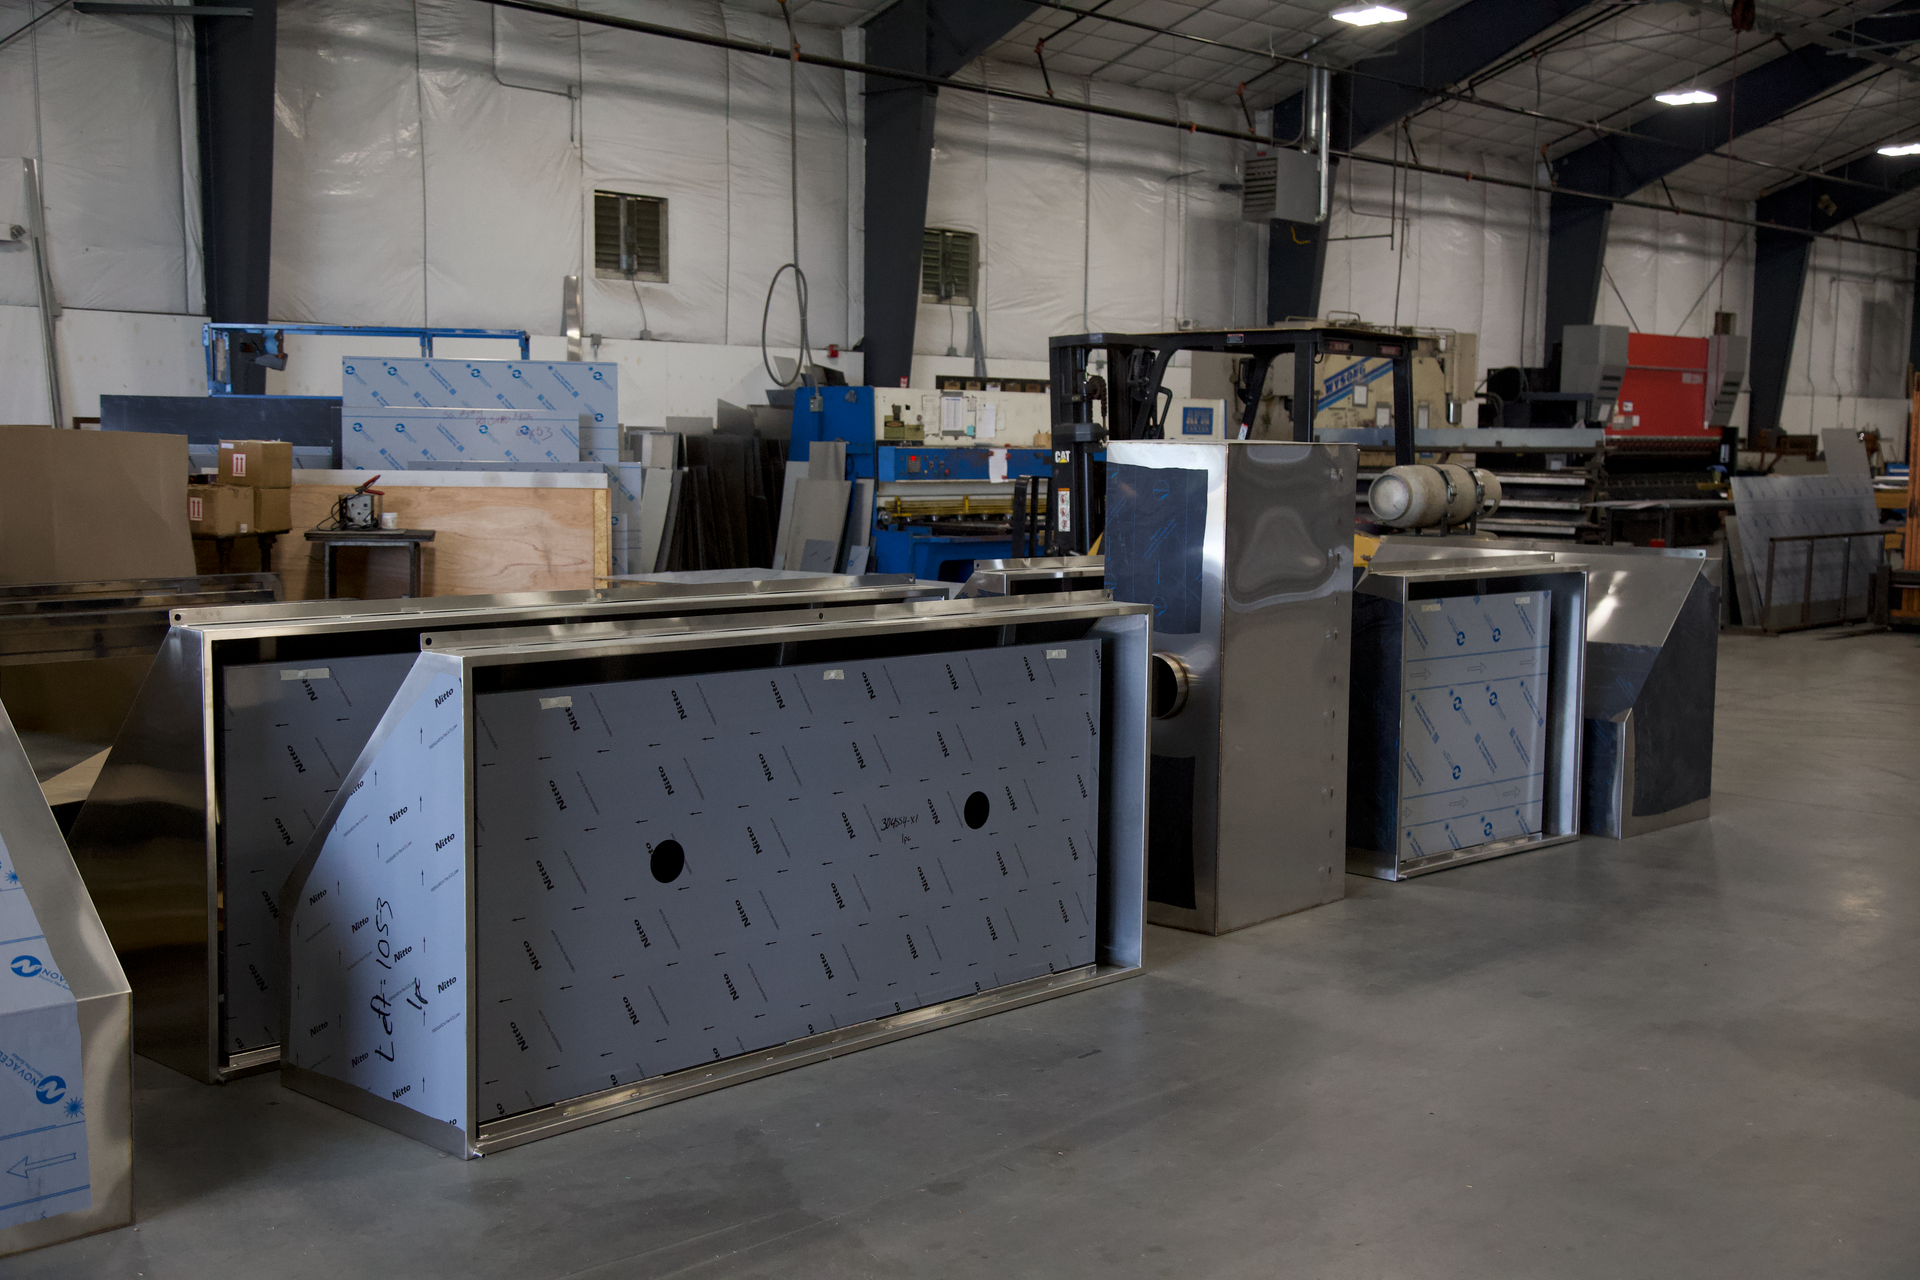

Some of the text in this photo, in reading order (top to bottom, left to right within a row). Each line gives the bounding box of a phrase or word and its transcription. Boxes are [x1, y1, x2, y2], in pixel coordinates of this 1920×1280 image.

[1325, 363, 1366, 395] WYSONG
[1055, 451, 1070, 463] CAT
[946, 664, 959, 690] Nitto
[1024, 657, 1035, 682] Nitto
[302, 678, 319, 702] Nitt
[435, 688, 453, 708] Nitto
[771, 681, 785, 709] Nitto
[862, 672, 876, 699] Nitto
[671, 690, 687, 720] Nitto
[565, 707, 581, 732] Nitt
[1086, 712, 1096, 735] Nitto
[937, 731, 950, 757] Nitto
[1015, 721, 1026, 746] Nitto
[287, 745, 306, 773] Nitto
[759, 753, 774, 782] Nitto
[852, 742, 866, 769] Nitto
[659, 766, 674, 795] Nitto
[1077, 775, 1087, 798] Nitto
[549, 780, 567, 811] Nitto
[1006, 786, 1017, 811] Nitto
[389, 807, 407, 824] Nitto
[928, 799, 940, 824] Nitto
[275, 818, 294, 846] Nitto
[842, 812, 856, 839] Nitto
[435, 834, 455, 851] Nitto
[747, 827, 762, 854] Nitto
[1068, 837, 1078, 861] Nitto
[536, 860, 554, 890] Nitto
[996, 851, 1008, 876] Nitto
[918, 867, 930, 892] Nitto
[261, 890, 279, 919] Nitto
[309, 888, 327, 906] Nitto
[831, 883, 845, 909] Nitto
[736, 900, 751, 927] Nitto
[1059, 900, 1069, 923] Nitto
[350, 916, 369, 934] Nitto
[634, 919, 651, 948] Nitto
[986, 917, 998, 941] Nitto
[394, 946, 412, 963] Nitto
[524, 941, 542, 971] Nitto
[906, 934, 918, 959] Nitto
[248, 963, 268, 992] Nitto
[820, 953, 834, 980] Nitto
[438, 977, 456, 993] Nitto
[724, 974, 739, 1001] Nitto
[623, 997, 639, 1025] Nitto
[310, 1022, 328, 1037] Nitto
[510, 1022, 528, 1051] Nitto
[351, 1052, 369, 1068] Nitto
[391, 1084, 411, 1100] Nitto
